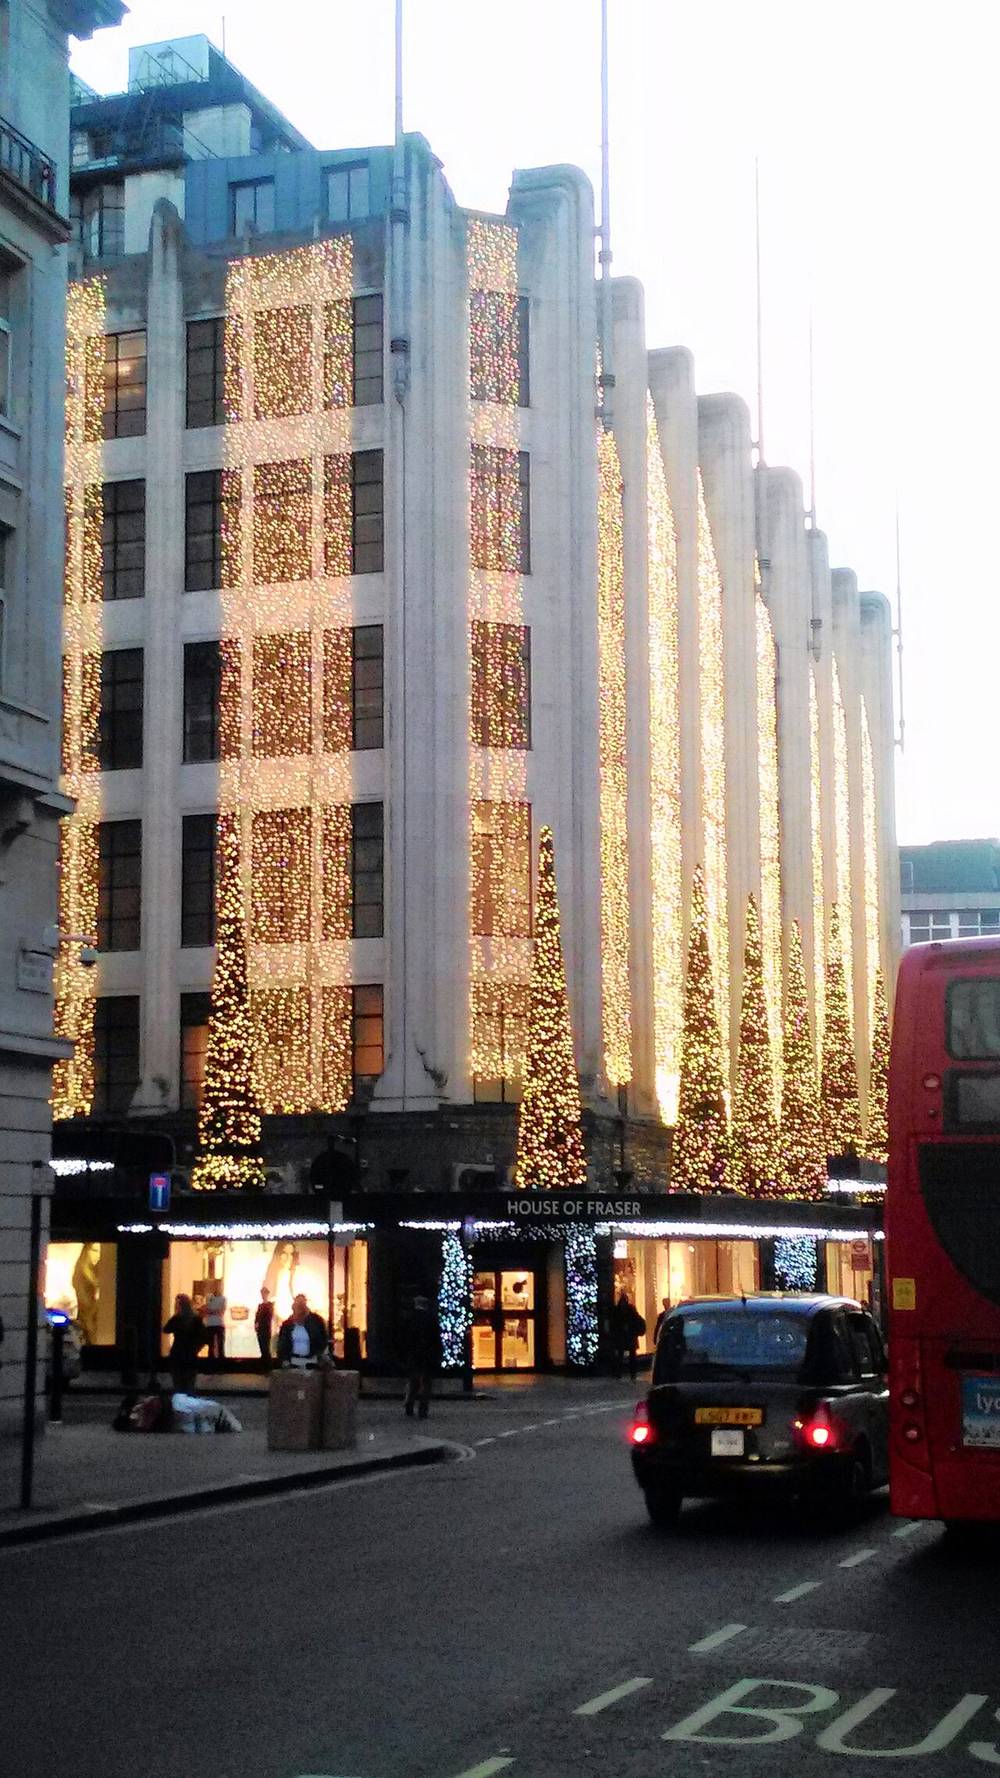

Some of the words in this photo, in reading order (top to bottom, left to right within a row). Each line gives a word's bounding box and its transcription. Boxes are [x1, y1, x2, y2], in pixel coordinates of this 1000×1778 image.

[507, 1201, 559, 1215] HOUSE
[563, 1201, 584, 1215] OF
[587, 1201, 641, 1215] FRASER
[661, 1678, 1000, 1763] BU
